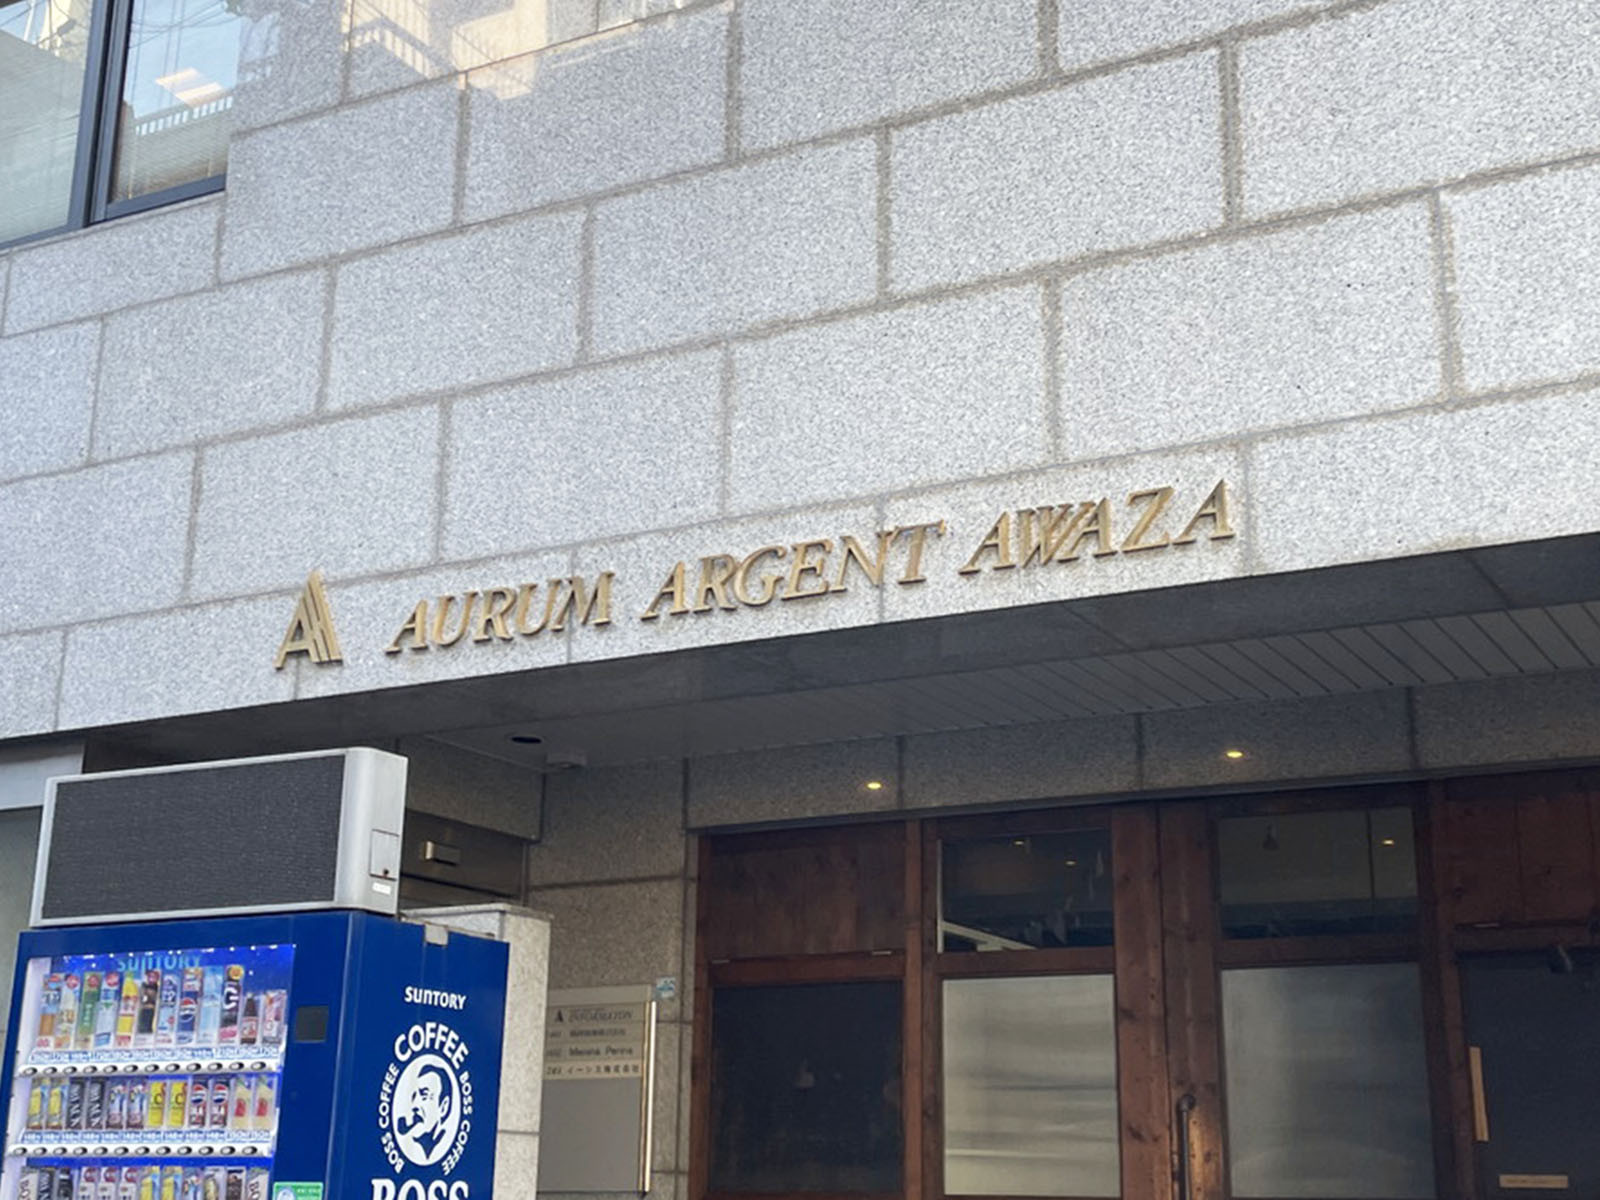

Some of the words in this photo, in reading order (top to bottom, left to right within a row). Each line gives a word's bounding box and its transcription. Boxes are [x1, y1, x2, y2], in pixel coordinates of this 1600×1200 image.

[384, 570, 615, 655] AURUM
[640, 519, 947, 621] ARGENT
[958, 479, 1236, 576] AWAZA
[404, 985, 467, 1011] SUNTORY
[394, 1021, 470, 1070] COFFEE
[378, 1062, 400, 1129] COFFEE
[458, 1071, 473, 1115] BOSS
[379, 1132, 405, 1174] BOSS
[442, 1119, 471, 1176] COFFEE
